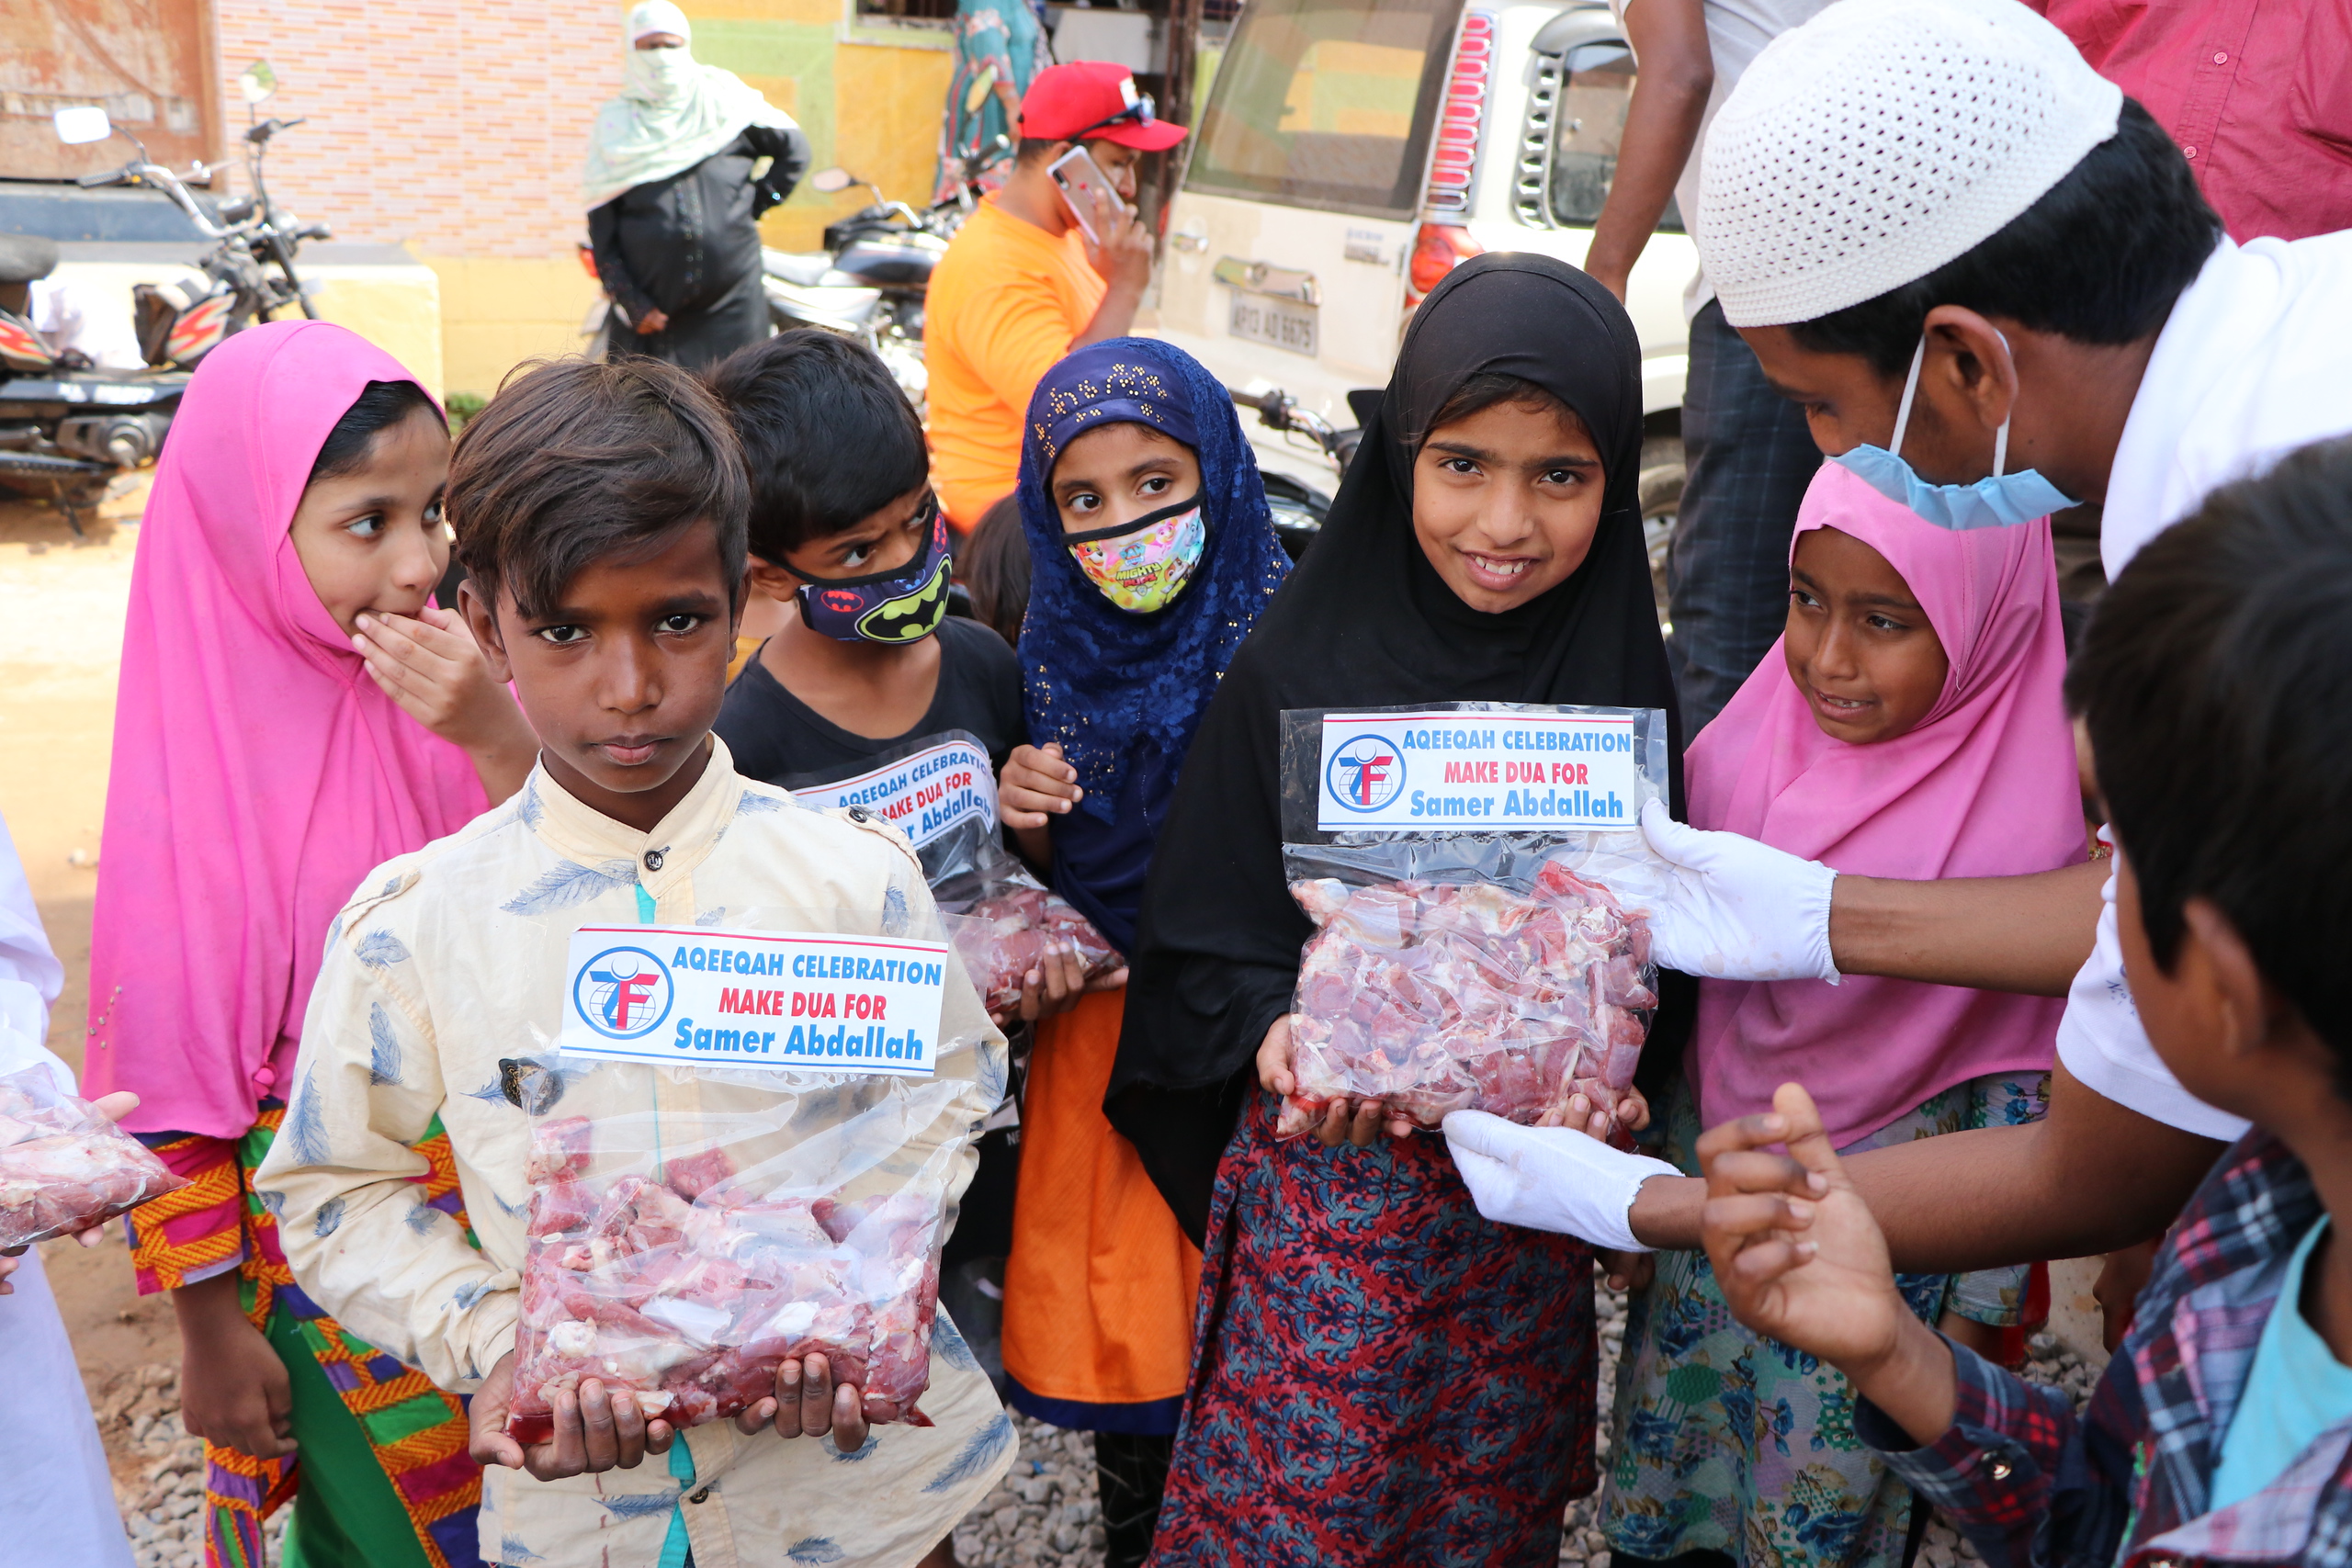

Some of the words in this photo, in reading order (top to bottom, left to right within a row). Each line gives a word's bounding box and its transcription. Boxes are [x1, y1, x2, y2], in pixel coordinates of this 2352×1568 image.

[1116, 561, 1162, 581] MIGHTY
[1402, 729, 1496, 750] AQEEQAH
[1502, 730, 1631, 752] CELEBRATION
[839, 773, 908, 808] AQEEQAH
[911, 751, 988, 783] CELEBRATIO
[916, 783, 944, 808] DUA
[945, 772, 972, 794] FOR
[1444, 761, 1498, 784] MAKE
[1506, 761, 1545, 784] DUA
[1552, 762, 1589, 785] FOR
[922, 788, 991, 835] Abdallah
[1410, 789, 1495, 817] Samer
[1502, 788, 1623, 818] Abdallah
[671, 946, 785, 976] AQEEQAH
[792, 953, 943, 987] CELEBRATION
[718, 987, 785, 1016] MAKE
[790, 991, 837, 1019] DUA
[843, 993, 888, 1021] FOR
[673, 1017, 776, 1054] Samer
[783, 1023, 923, 1061] Abdallah
